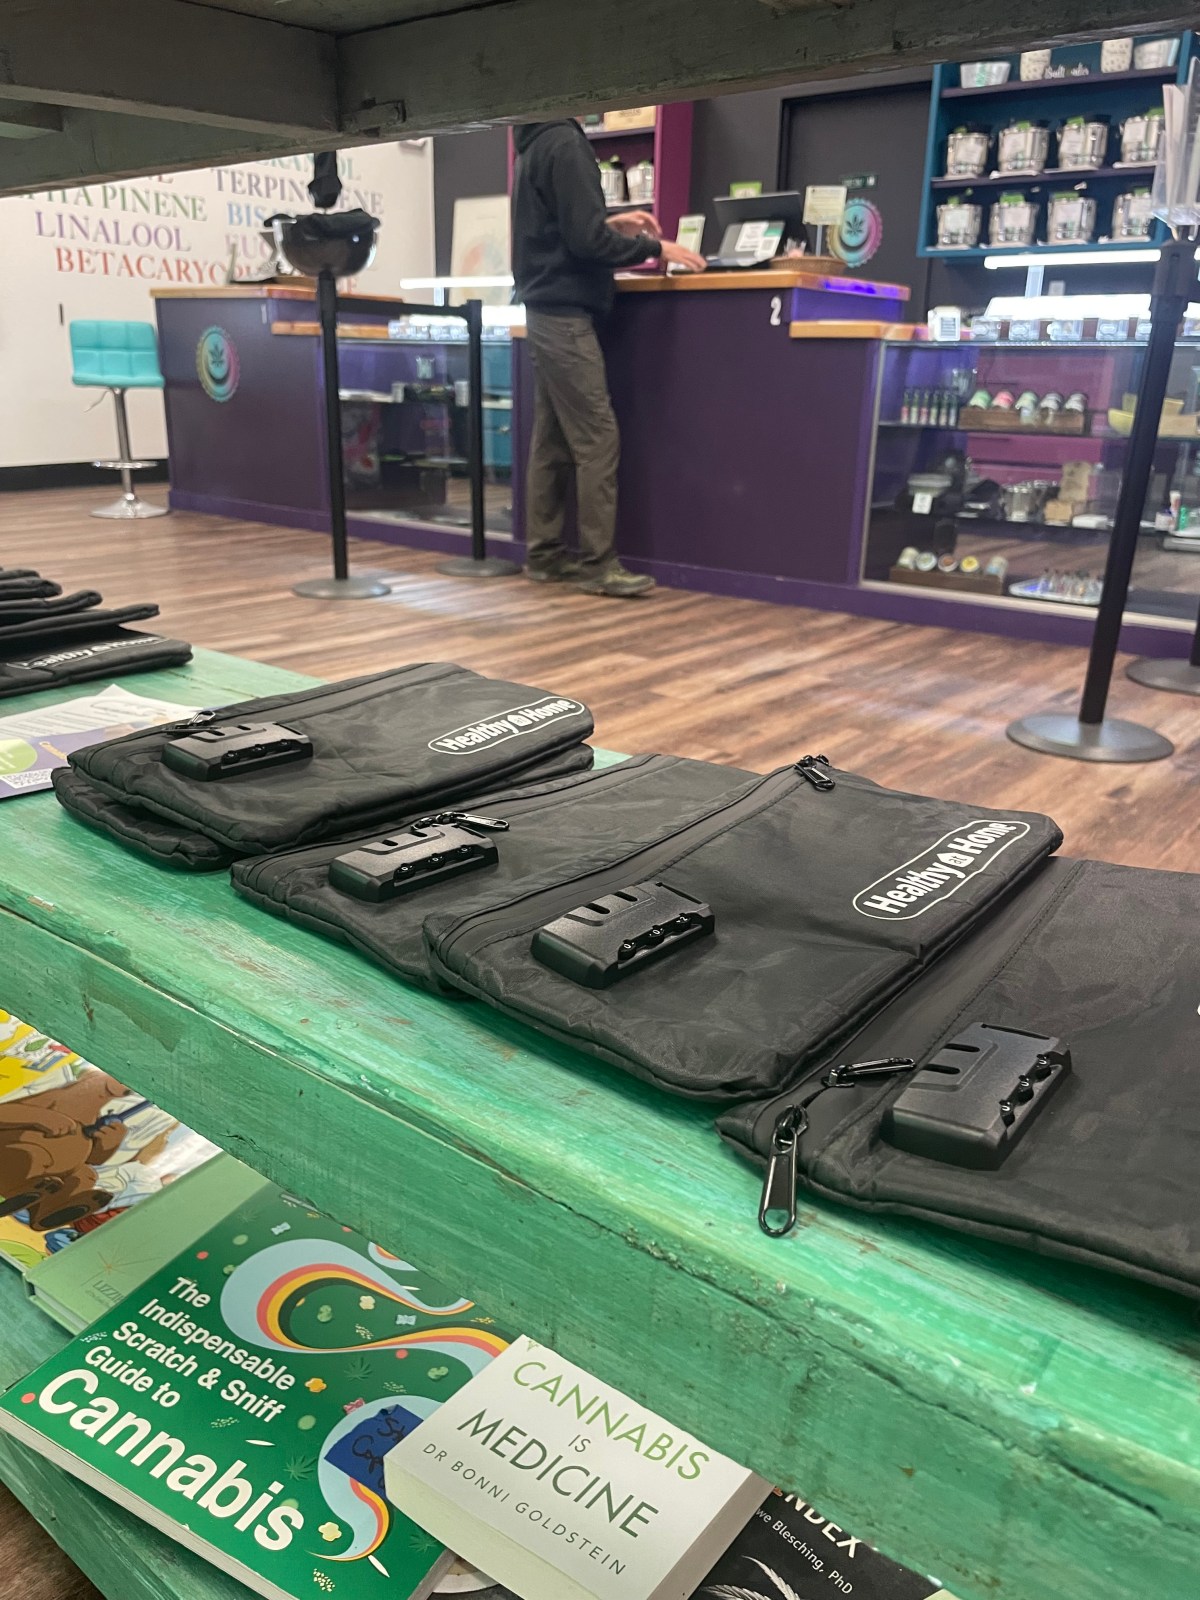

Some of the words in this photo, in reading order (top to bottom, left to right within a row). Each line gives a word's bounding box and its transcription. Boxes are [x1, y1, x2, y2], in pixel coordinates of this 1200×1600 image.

[101, 184, 208, 222] PINENE
[211, 168, 384, 216] TERPINENE
[35, 210, 192, 251] LINALOOL
[770, 298, 782, 326] 2
[436, 717, 520, 751] Healthy
[517, 699, 577, 722] Home
[863, 862, 966, 914] Healthy
[947, 822, 1017, 855] Home
[168, 1276, 211, 1308] The
[85, 1345, 153, 1393] Guide
[151, 1383, 181, 1408] to
[112, 1321, 197, 1379] Scratch
[197, 1370, 216, 1390] &
[220, 1377, 287, 1423] Sniff
[139, 1298, 296, 1391] Indispensable
[512, 1361, 710, 1481] CANNABIS
[569, 1434, 591, 1454] IS
[38, 1369, 304, 1551] Cannabis
[457, 1408, 659, 1538] MEDICINE
[423, 1443, 446, 1464] DR
[451, 1459, 511, 1503] BONNI
[515, 1501, 627, 1576] GOLDSTEIN
[756, 1509, 772, 1523] we
[772, 1520, 824, 1572] Blesching,
[828, 1570, 853, 1595] PhD
